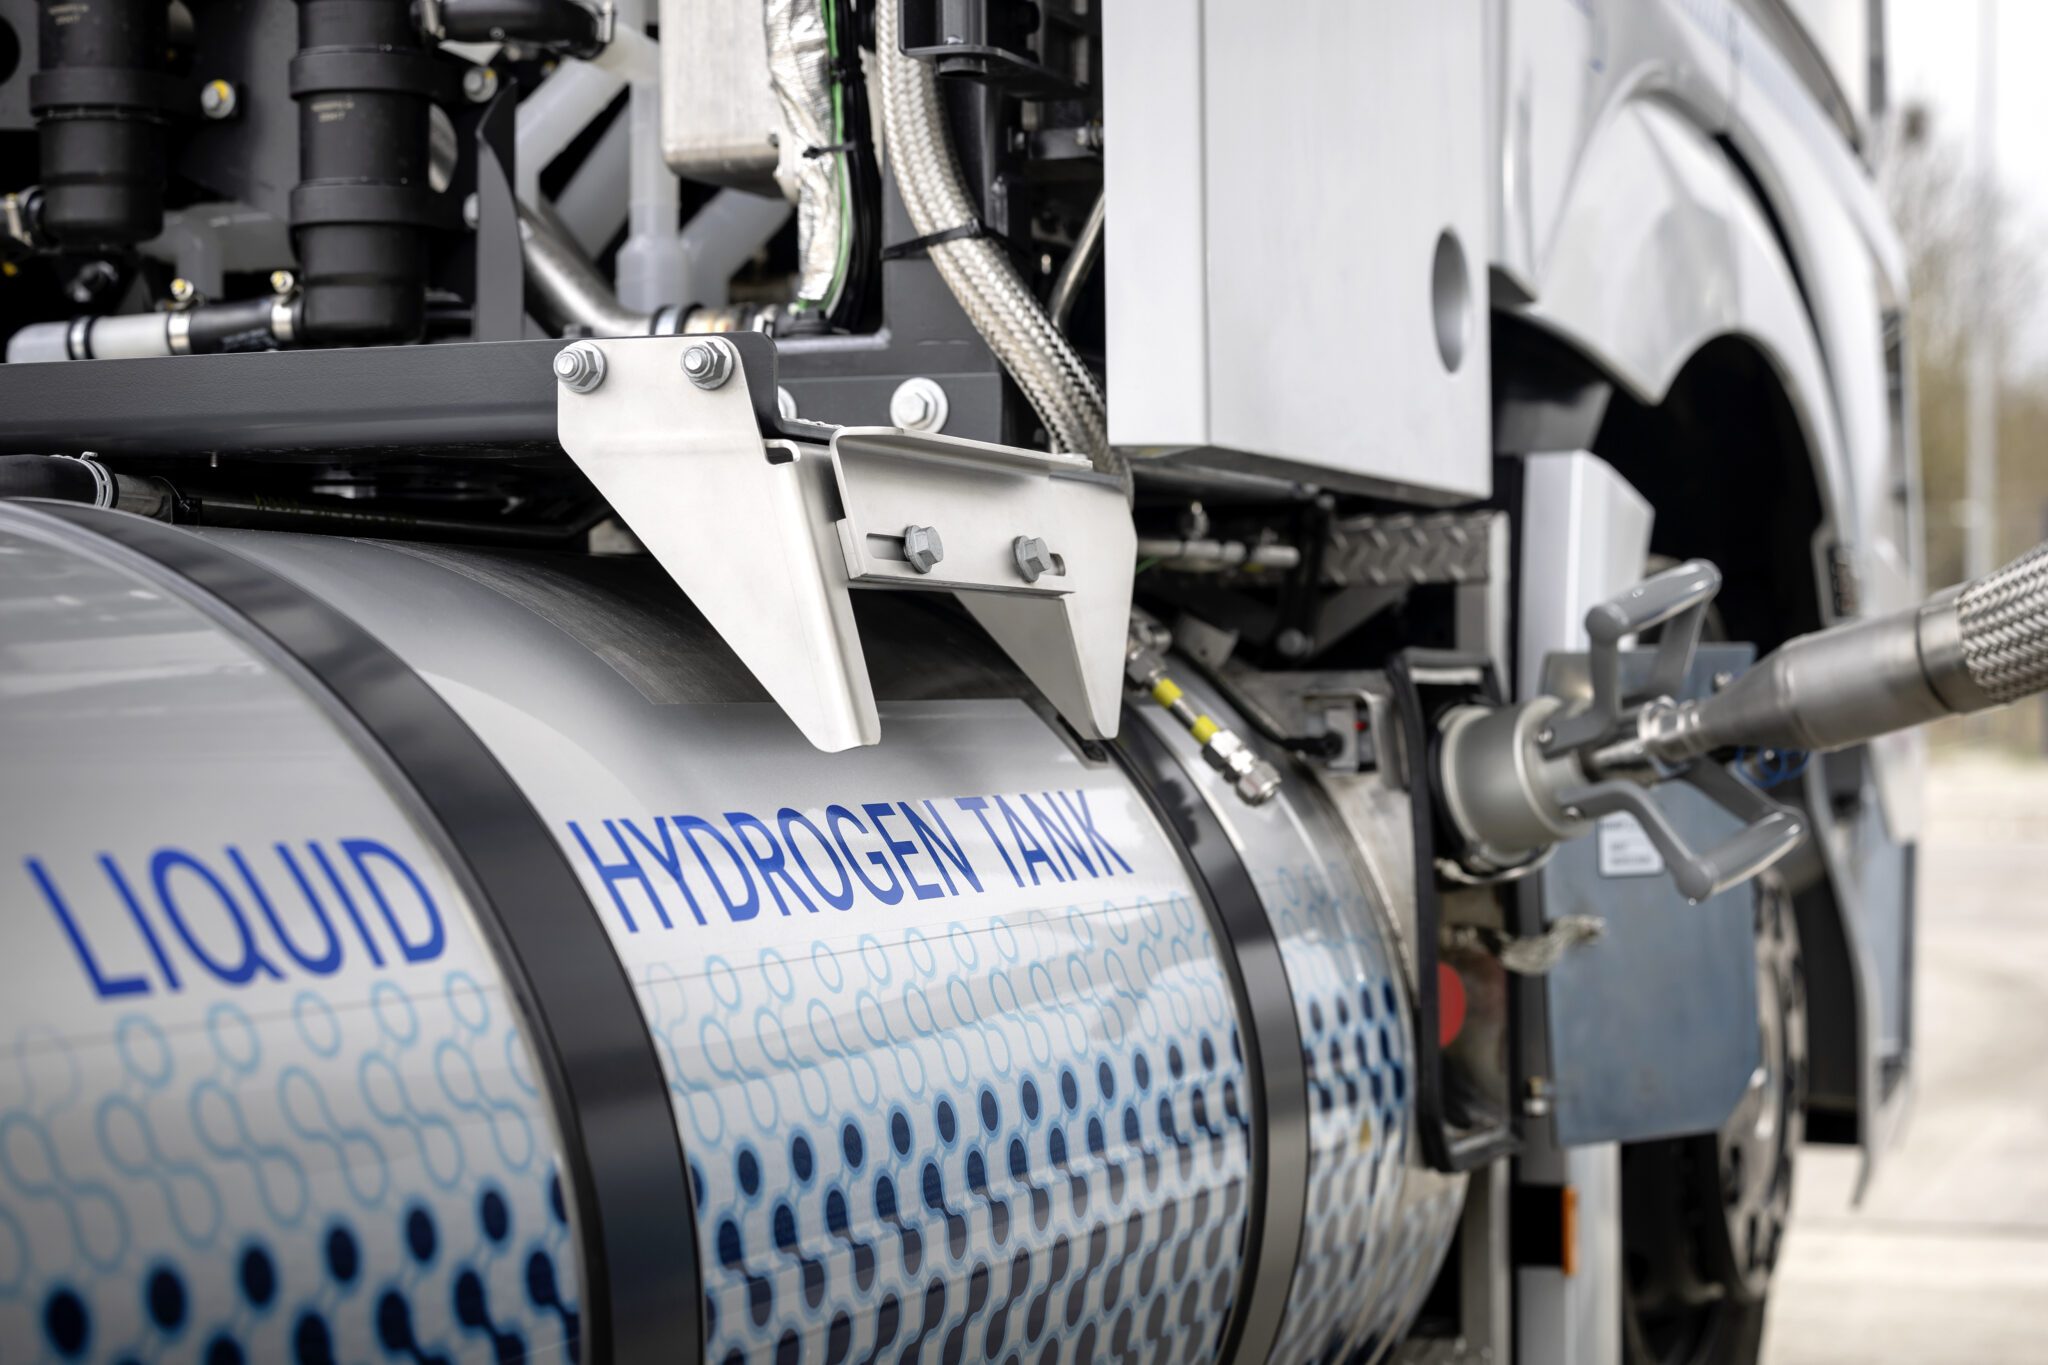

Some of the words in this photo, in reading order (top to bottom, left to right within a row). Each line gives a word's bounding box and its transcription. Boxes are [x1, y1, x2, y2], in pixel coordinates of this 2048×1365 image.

[24, 837, 447, 1000] LIQUID
[565, 799, 985, 933] HYDROGEN
[954, 789, 1134, 888] TANK
